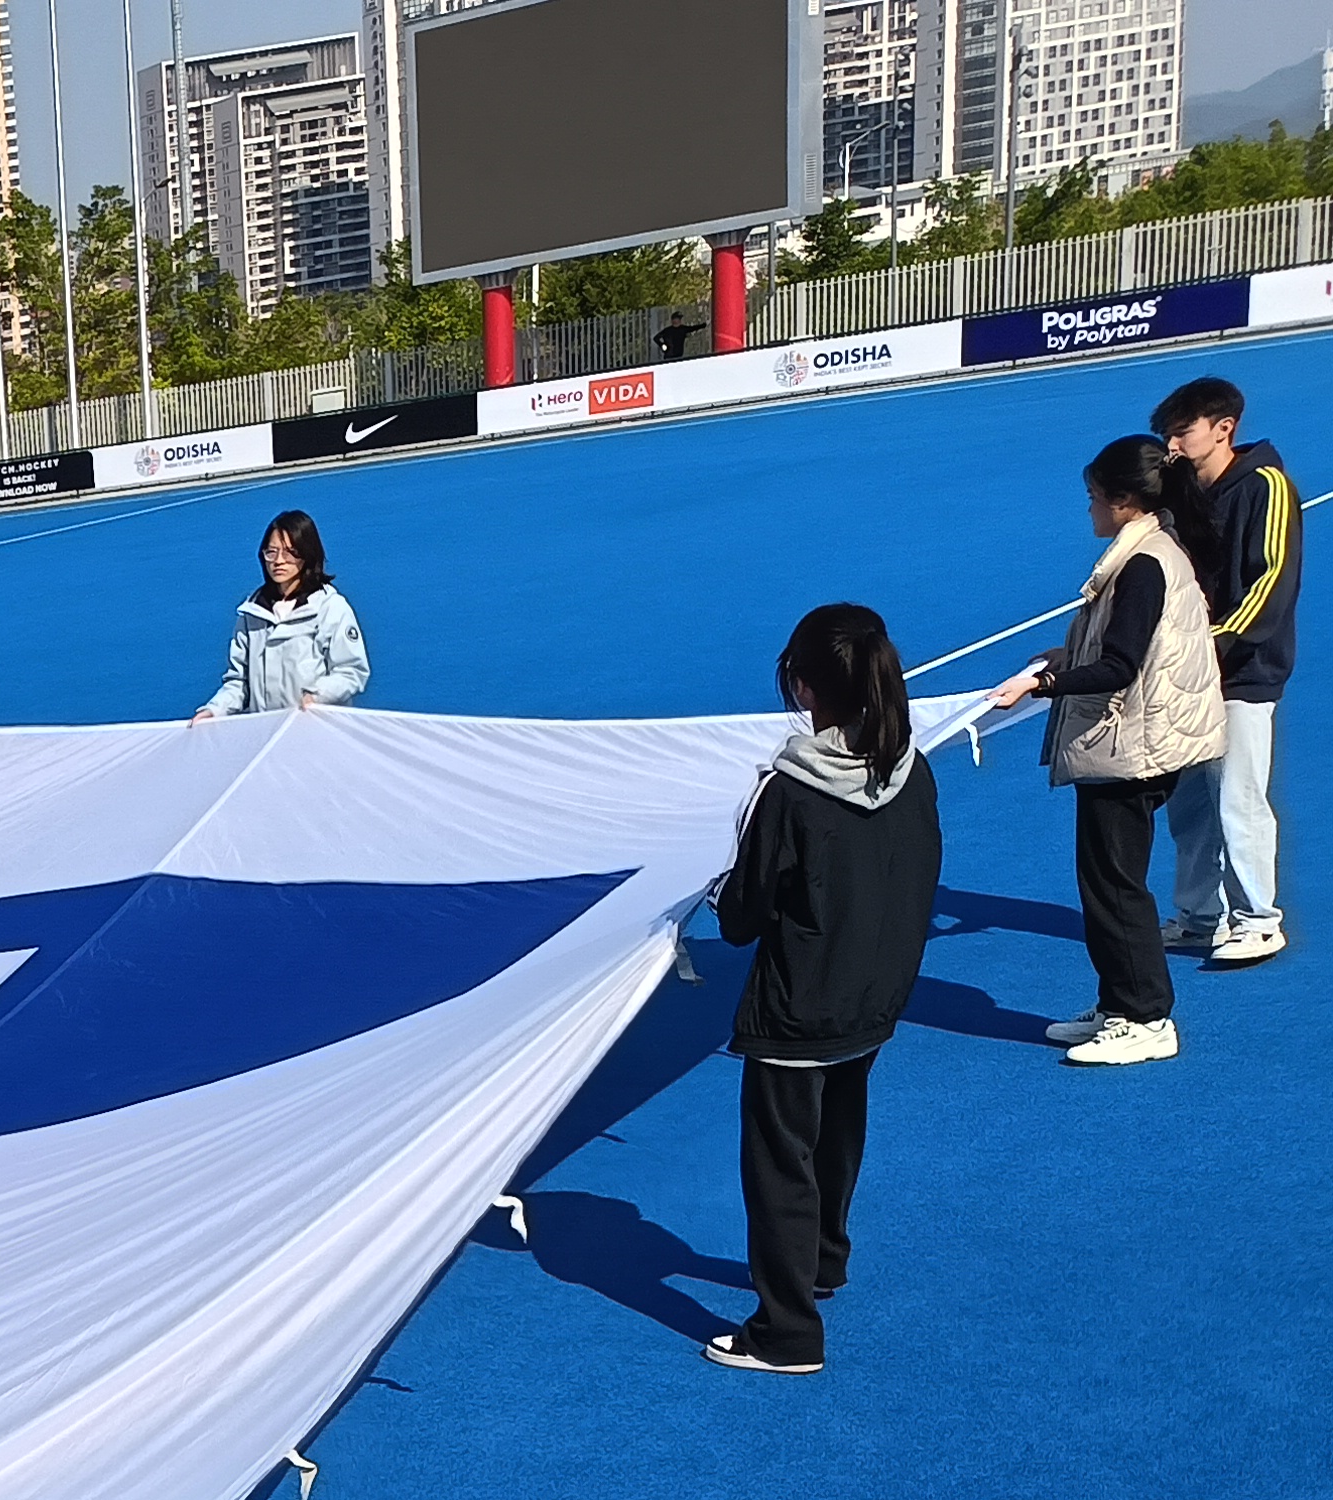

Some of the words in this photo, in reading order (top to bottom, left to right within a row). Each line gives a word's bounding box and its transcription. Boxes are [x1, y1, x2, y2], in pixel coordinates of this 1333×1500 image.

[1042, 299, 1157, 333] POLIGRAS
[1047, 334, 1070, 350] by
[1074, 323, 1150, 345] Polytan
[813, 344, 892, 369] ODISHA
[593, 383, 649, 405] VIDA
[164, 441, 222, 461] ODISHA
[35, 481, 57, 493] NOW
